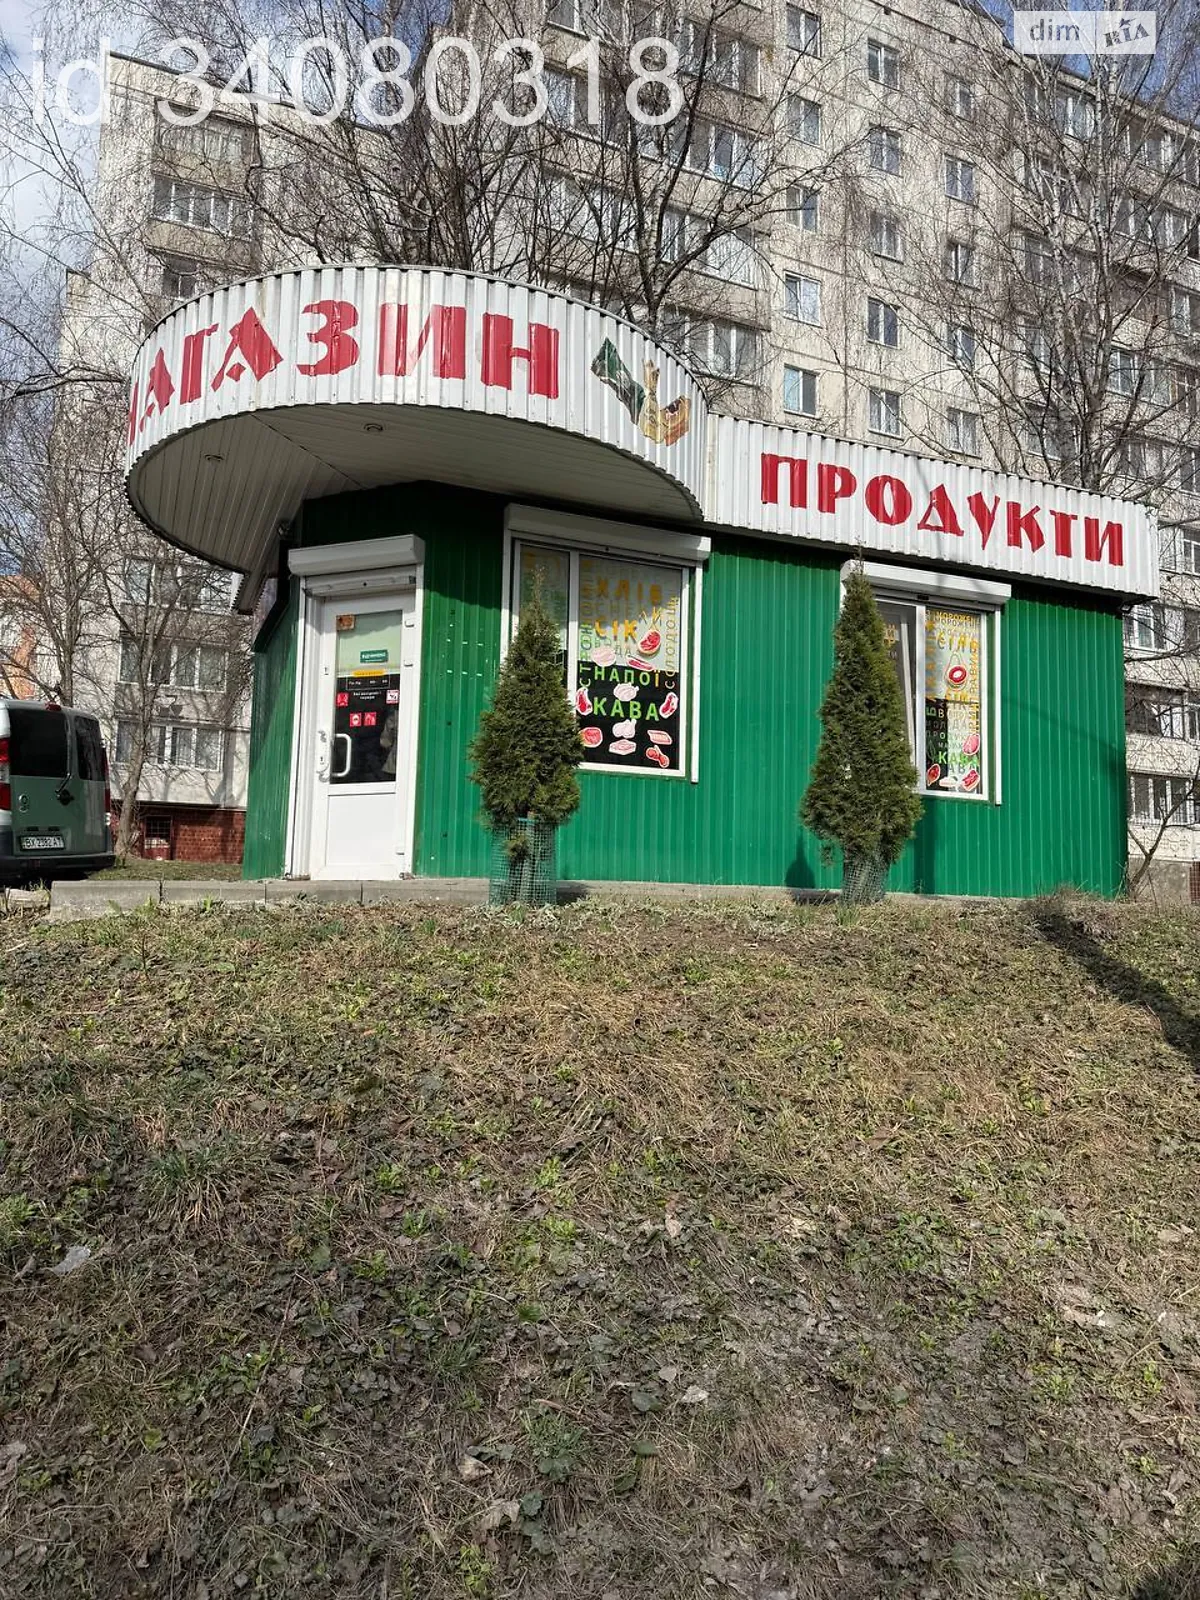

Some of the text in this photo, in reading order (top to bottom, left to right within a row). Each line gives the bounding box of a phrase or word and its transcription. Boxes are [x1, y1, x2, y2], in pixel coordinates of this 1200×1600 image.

[760, 452, 1124, 567] ПРОДУКТИ
[594, 666, 660, 687] НАПОЇ
[593, 697, 660, 722] КАВА
